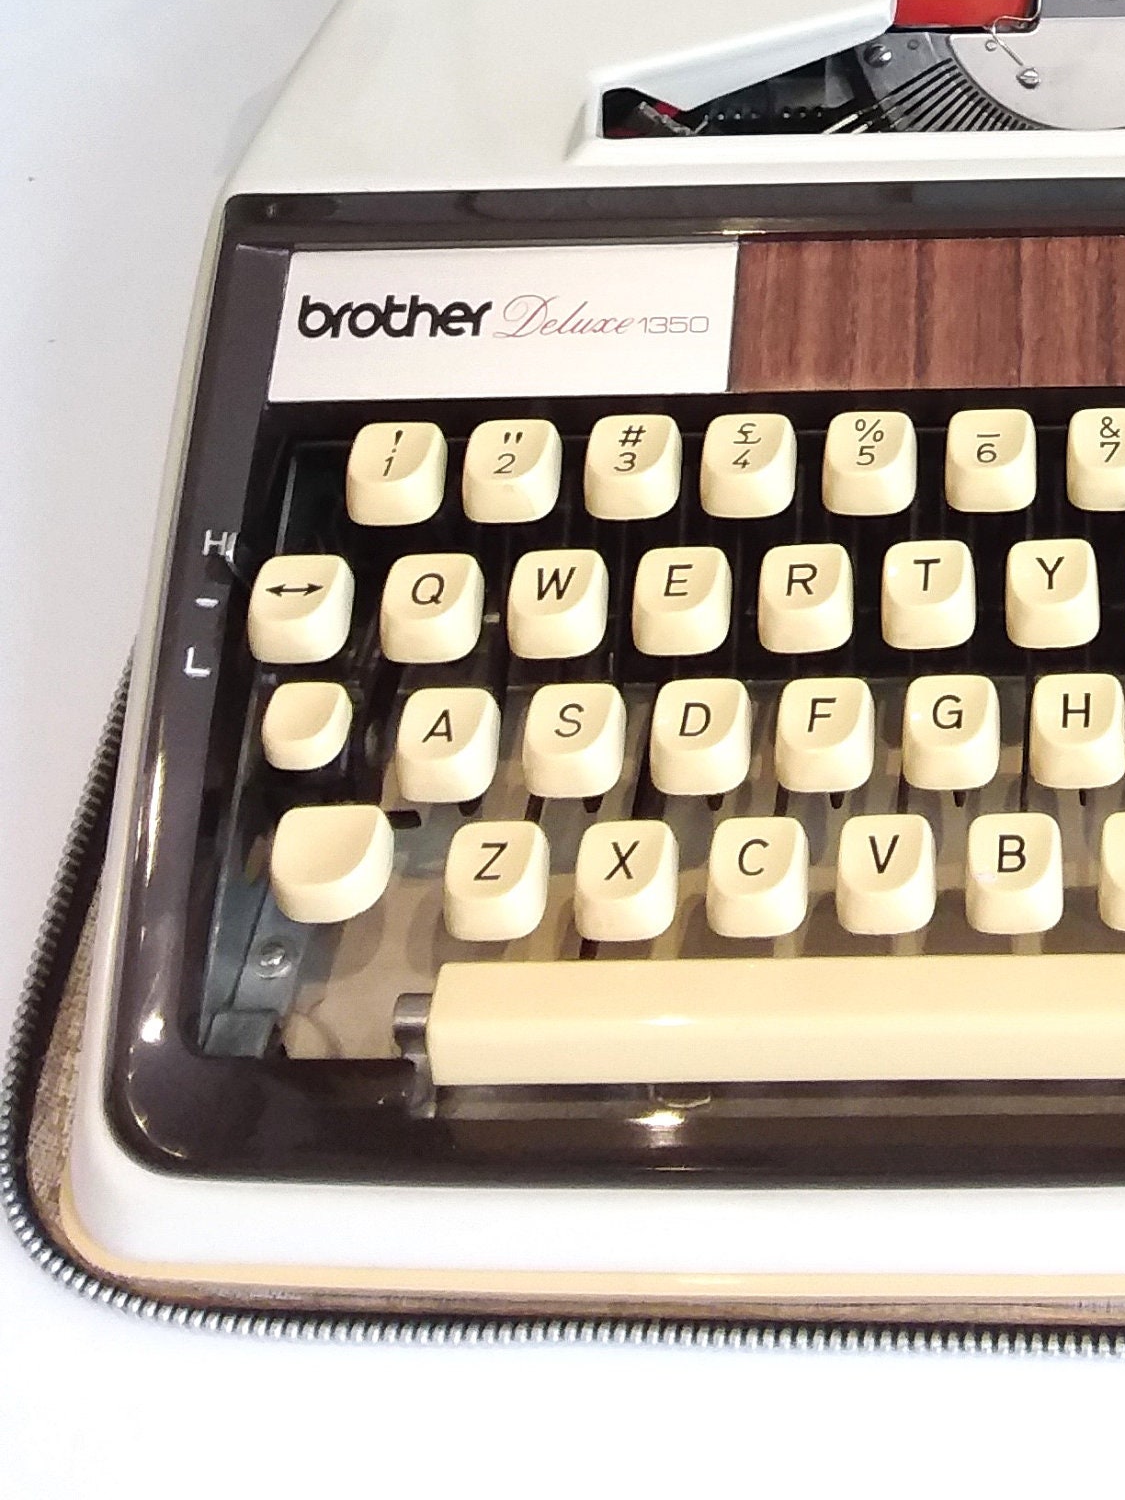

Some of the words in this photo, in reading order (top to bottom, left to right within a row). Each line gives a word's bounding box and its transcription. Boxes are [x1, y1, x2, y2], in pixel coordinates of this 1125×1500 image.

[299, 295, 493, 338] brother
[492, 293, 636, 339] Deluxe
[637, 314, 711, 336] 1350
[392, 430, 403, 453] !
[619, 426, 646, 447] #
[733, 423, 761, 444] £
[855, 419, 884, 447] %
[1100, 416, 1120, 438] &
[383, 456, 394, 476] 1
[493, 453, 515, 474] 2
[614, 452, 636, 472] 3
[732, 449, 750, 469] 4
[856, 446, 875, 465] 5
[977, 443, 997, 463] 6
[1100, 442, 1120, 462] 7
[202, 529, 228, 556] H
[412, 573, 444, 605] Q
[537, 567, 576, 600] W
[664, 564, 693, 596] E
[786, 564, 817, 596] R
[914, 558, 940, 591] T
[1036, 557, 1064, 589] Y
[184, 646, 211, 677] L
[422, 710, 452, 743] A
[554, 703, 584, 737] S
[679, 703, 711, 736] D
[808, 698, 836, 732] F
[933, 695, 963, 729] G
[1062, 693, 1091, 728] H
[474, 842, 508, 881] Z
[605, 841, 639, 880] X
[738, 839, 769, 876] C
[869, 835, 899, 874] V
[997, 835, 1026, 873] B
